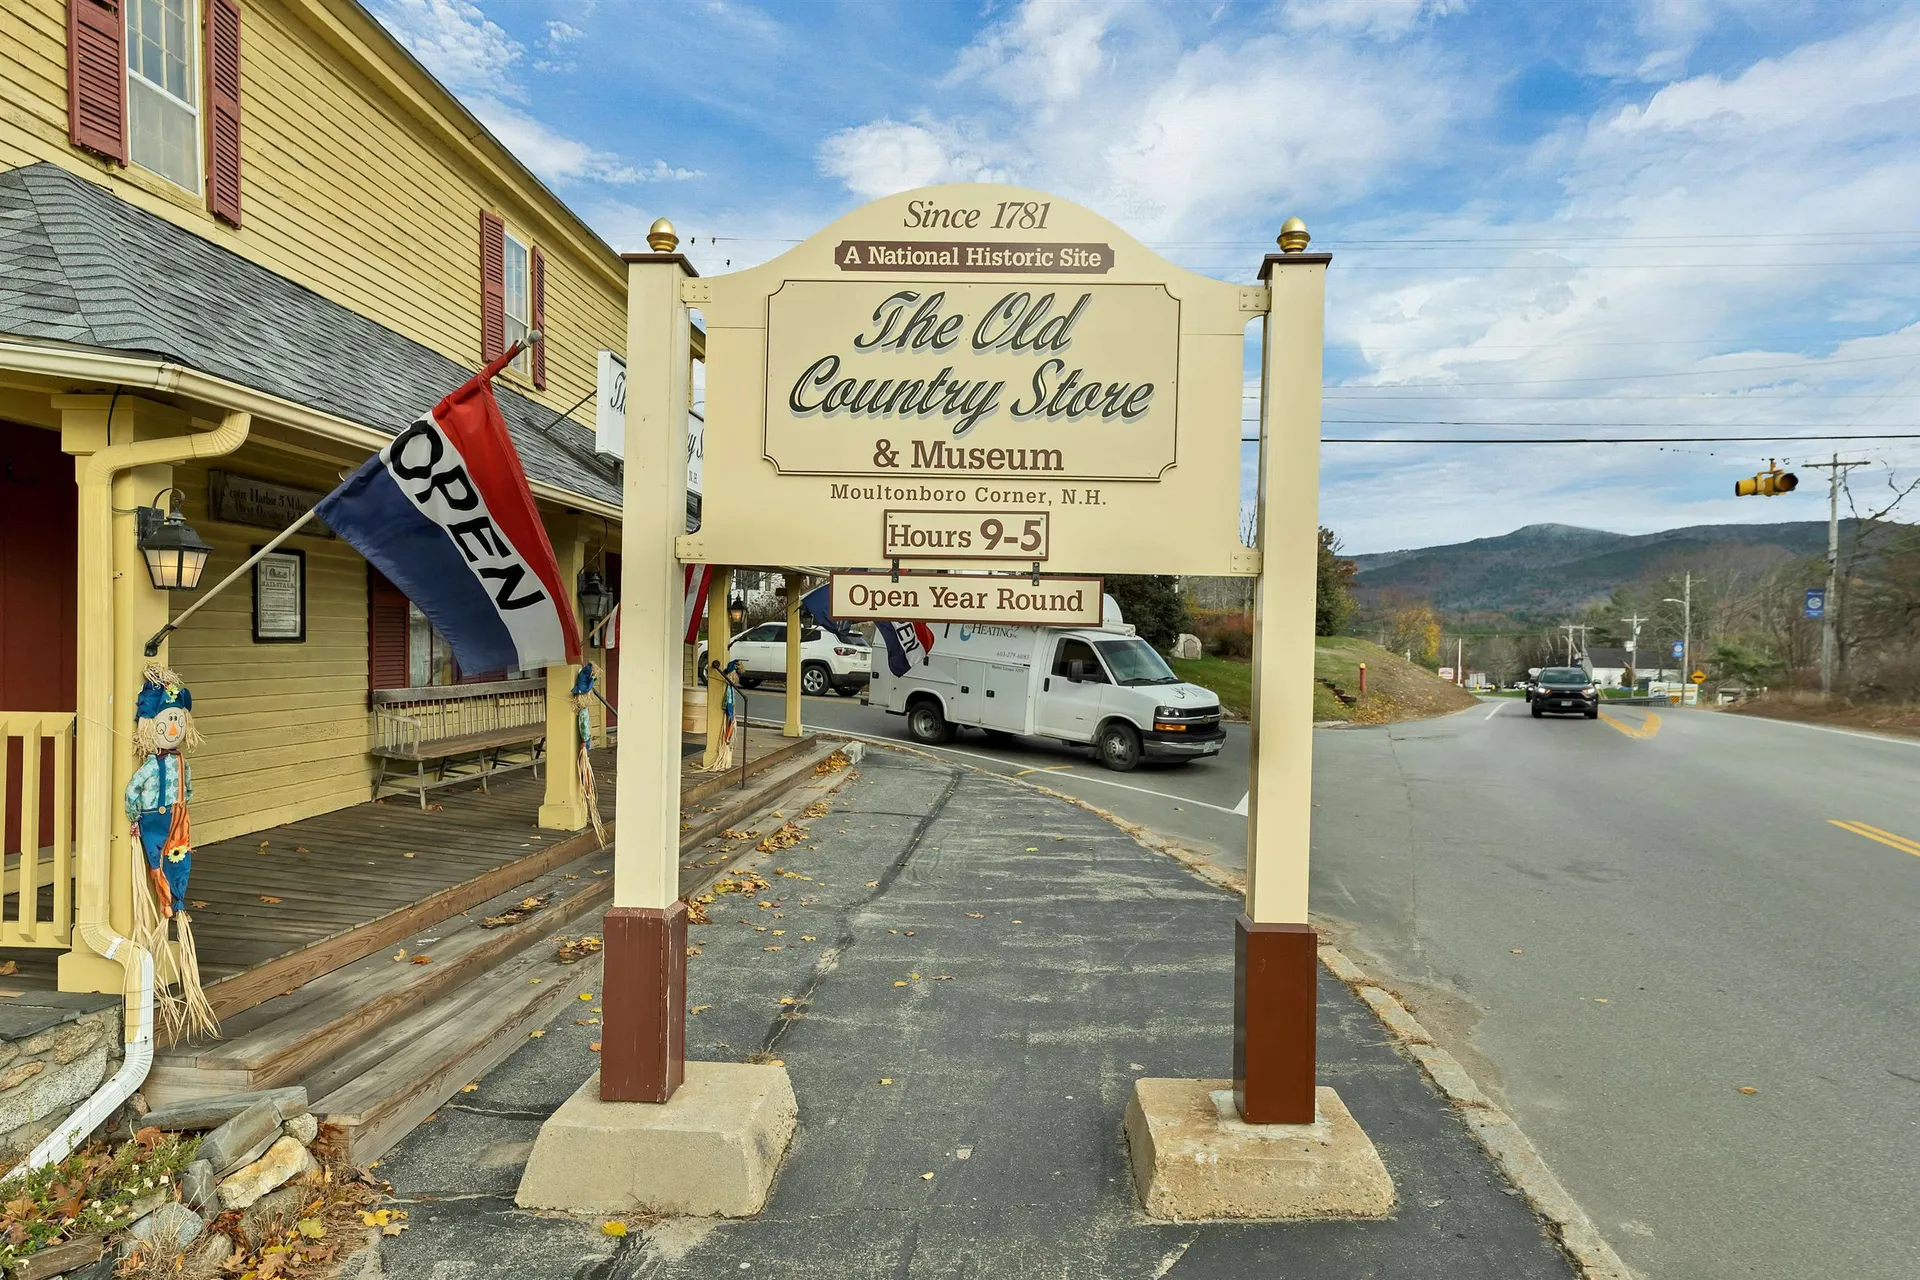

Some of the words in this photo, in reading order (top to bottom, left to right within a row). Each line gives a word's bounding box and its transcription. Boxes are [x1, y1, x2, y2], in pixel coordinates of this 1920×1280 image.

[903, 200, 981, 229] Since
[989, 201, 1051, 230] 1781
[843, 246, 861, 265] A
[868, 246, 960, 267] National
[966, 247, 1054, 268] Historic
[1060, 248, 1102, 268] Site
[853, 290, 966, 356] The
[971, 291, 1093, 357] Old
[788, 354, 1007, 438] Country
[1009, 358, 1156, 424] Store
[872, 438, 900, 469] &
[910, 439, 1065, 472] Museum
[830, 483, 967, 503] Moultonboro
[975, 486, 1053, 507] Corner,
[1061, 489, 1107, 506] N.H.
[389, 419, 548, 612] OPEN
[888, 524, 972, 549] Hours
[979, 518, 1042, 552] 9-5
[848, 584, 920, 612] Open
[929, 586, 988, 610] Year
[996, 588, 1085, 612] Round
[972, 623, 1013, 639] HEATING
